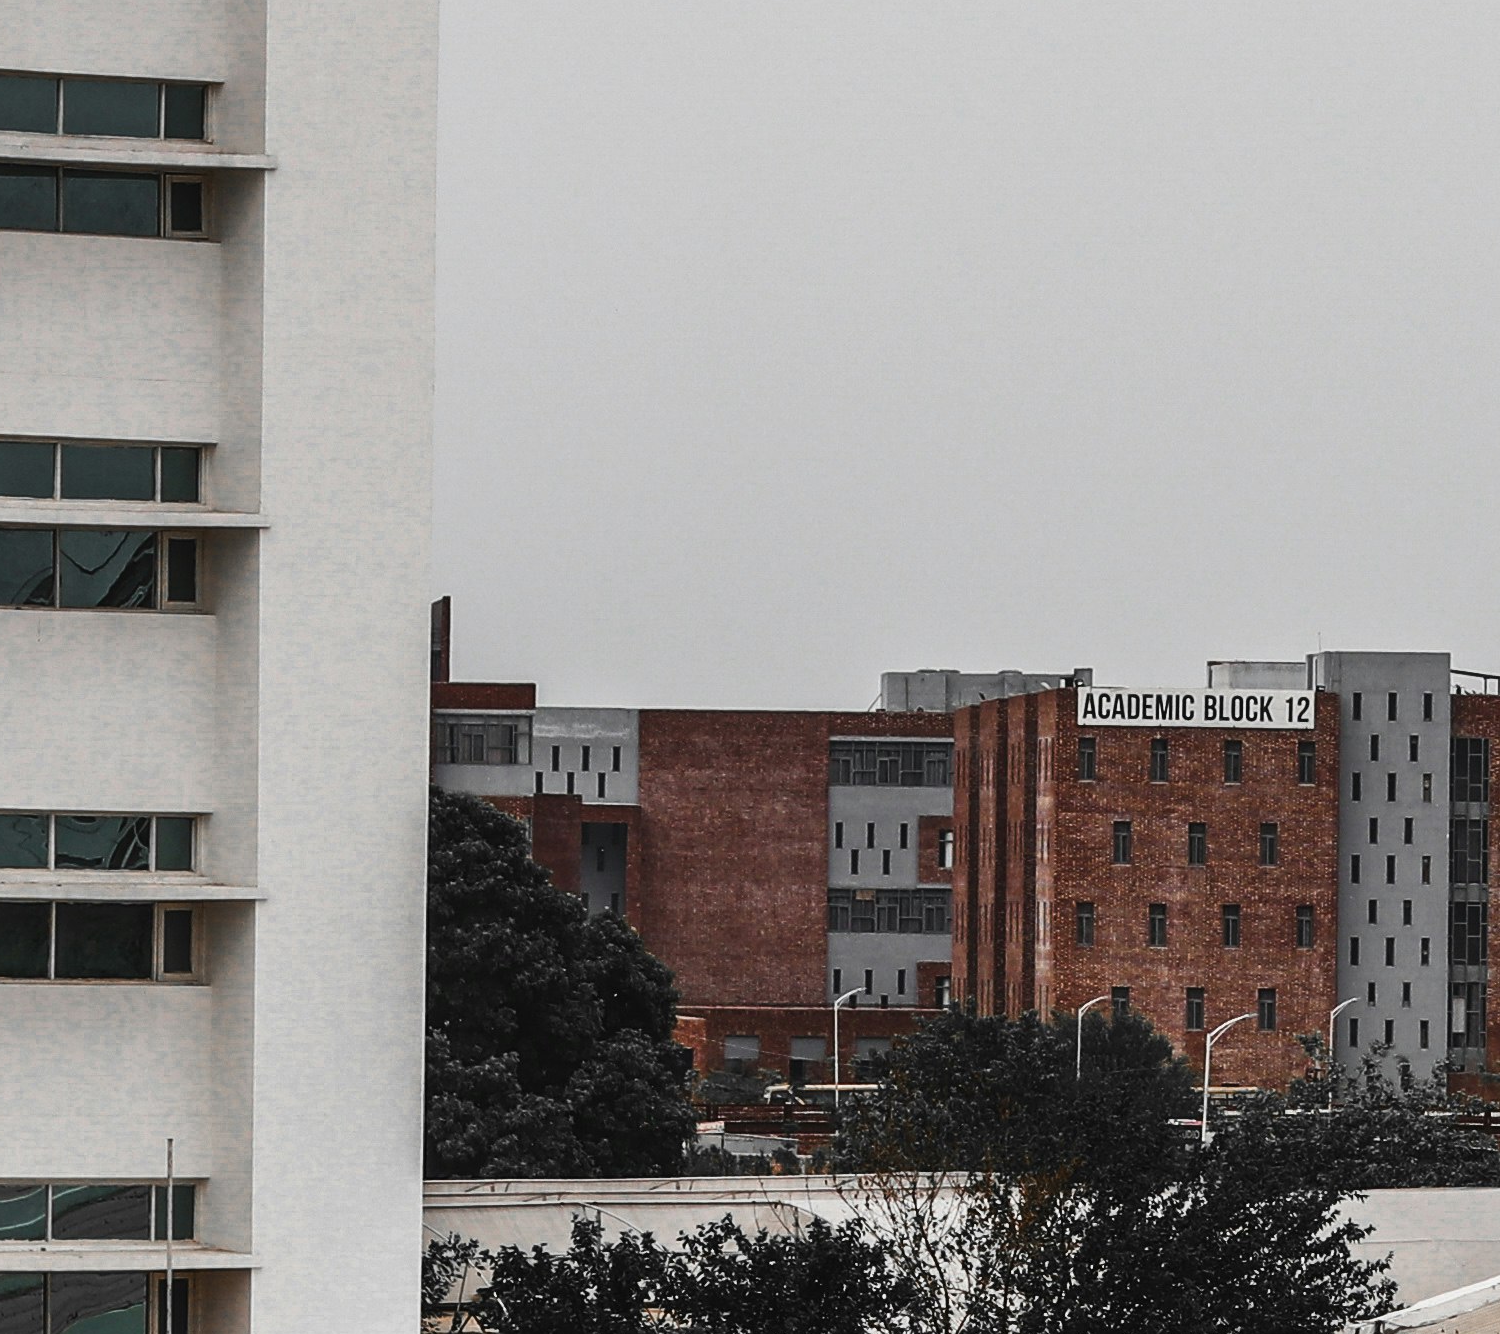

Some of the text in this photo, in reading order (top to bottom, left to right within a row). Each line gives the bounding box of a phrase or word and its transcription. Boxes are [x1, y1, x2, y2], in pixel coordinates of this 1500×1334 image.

[1082, 692, 1311, 723] ACADEMIC BLOCK 12
